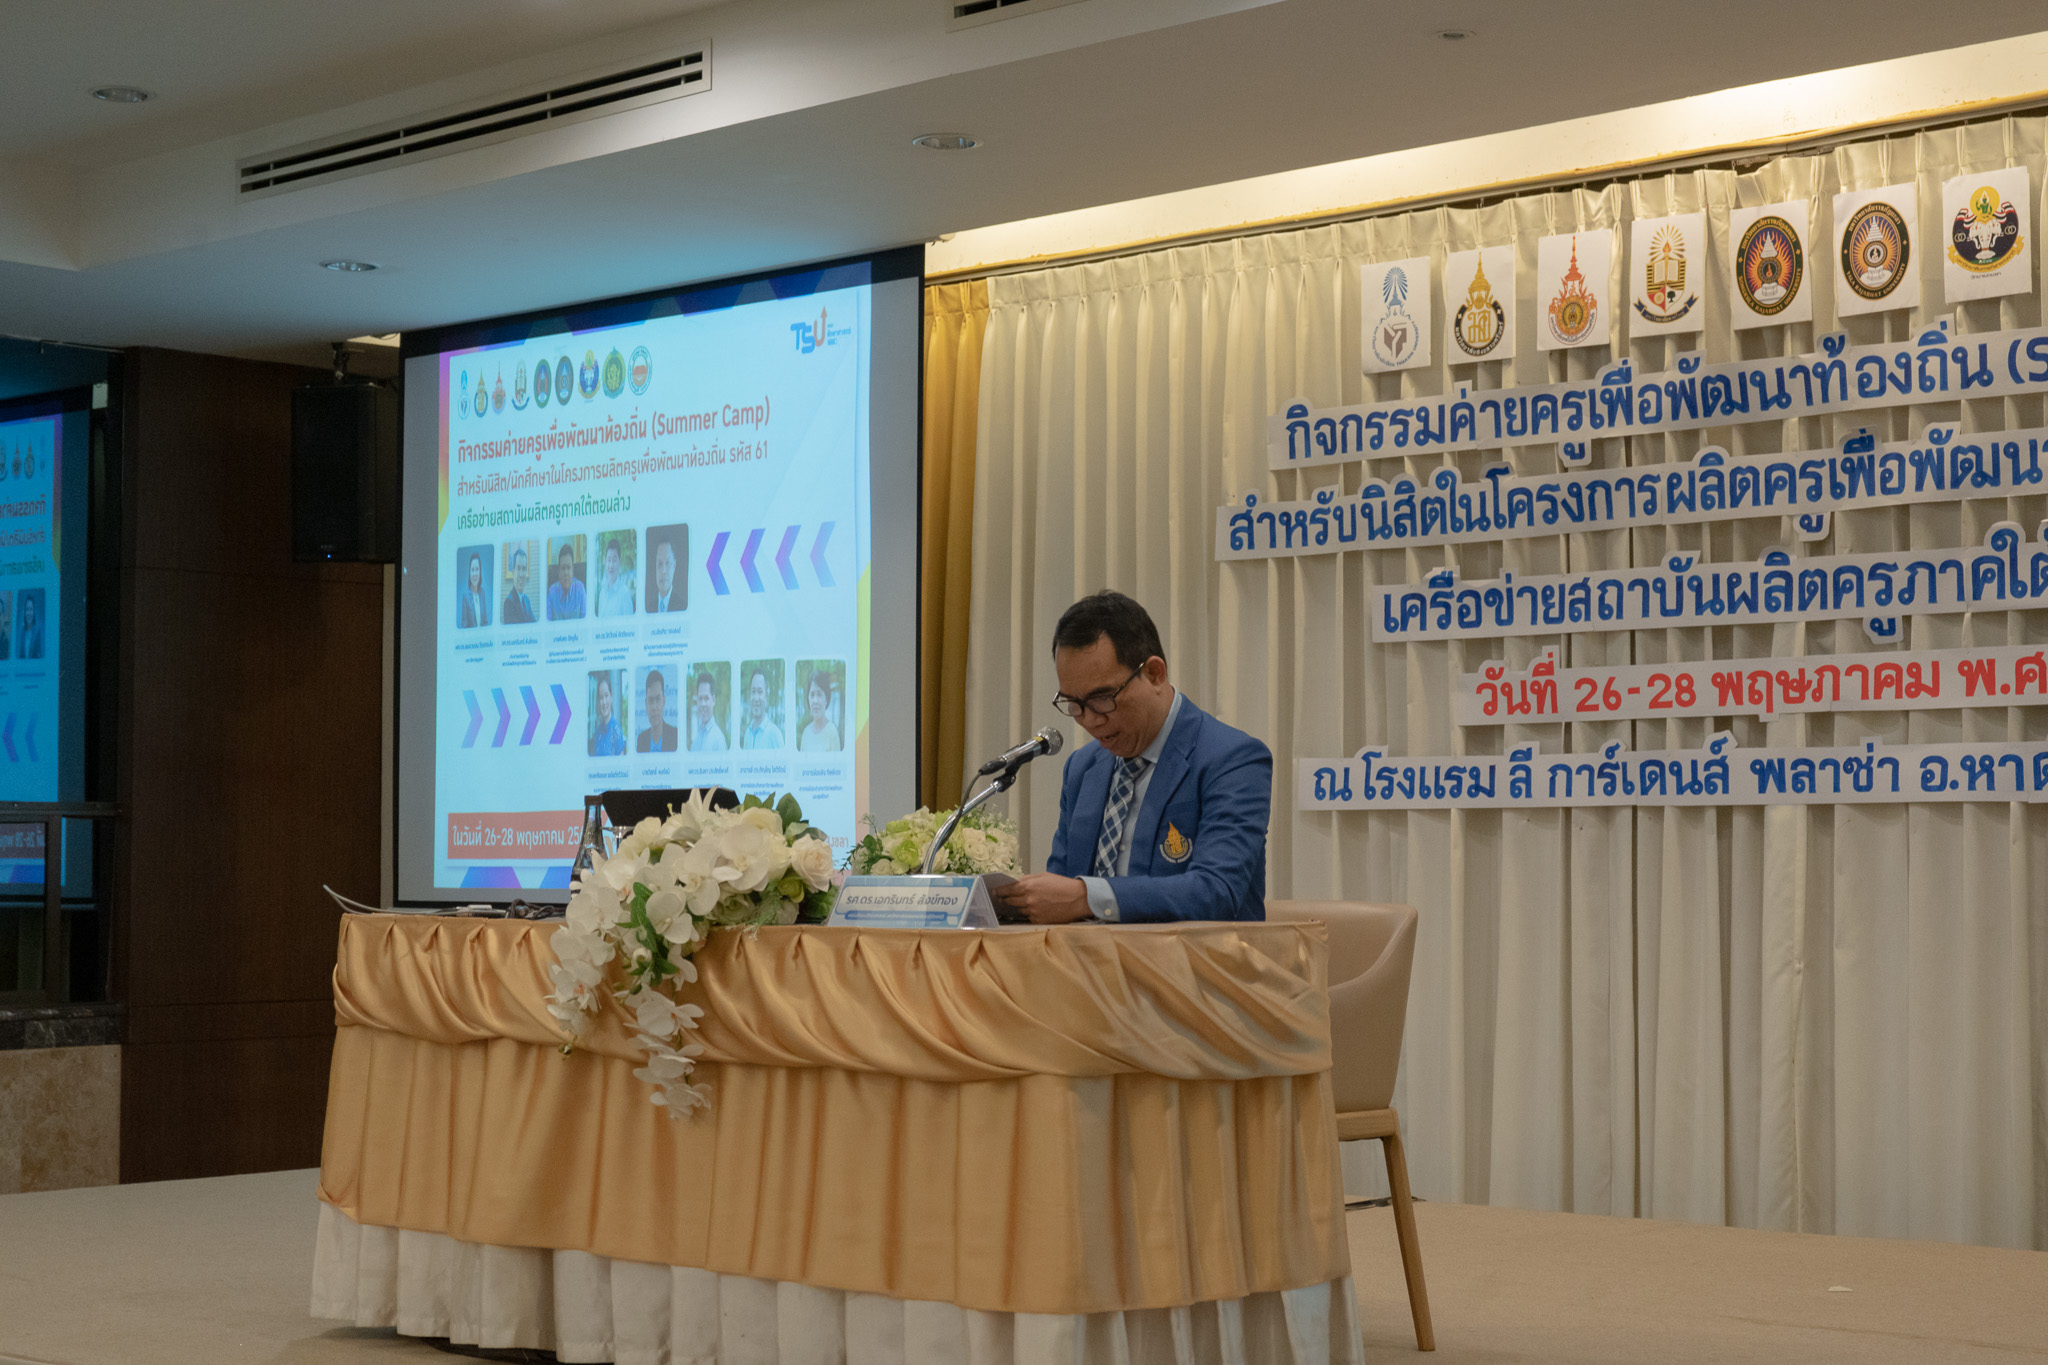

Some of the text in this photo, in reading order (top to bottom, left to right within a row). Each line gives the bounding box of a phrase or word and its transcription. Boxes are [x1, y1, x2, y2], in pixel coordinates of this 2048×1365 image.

[1883, 263, 1906, 295] UNIVERSITY
[1286, 321, 1994, 461] กิจกรรมค่ายครูเพื่อพัฒนาท้องถิ่น
[458, 395, 770, 464] กิจกรรมค่ายครูเพื่อพัฒนาท้องถิ่น (Summer Camp)
[729, 441, 752, 463] รหัส
[755, 440, 768, 460] 61
[1229, 427, 2048, 551] สำหรับนิสิตในโครงการผลิตครูเพื่อพัฒน
[1384, 528, 2048, 637] เครือข่ายสถาบันผลิตครูภาคใต
[1476, 652, 1559, 716] วันที่
[1574, 673, 1697, 713] 26-28
[1711, 661, 1940, 713] พฤษภาคม
[1509, 747, 1533, 798] ลี
[1548, 737, 1729, 797] การ์เดนส์
[1750, 743, 1900, 794] พลาซ่า
[453, 819, 482, 846] ในวันที่
[485, 826, 513, 846] 26-28
[516, 829, 565, 850] พฤษภาคม
